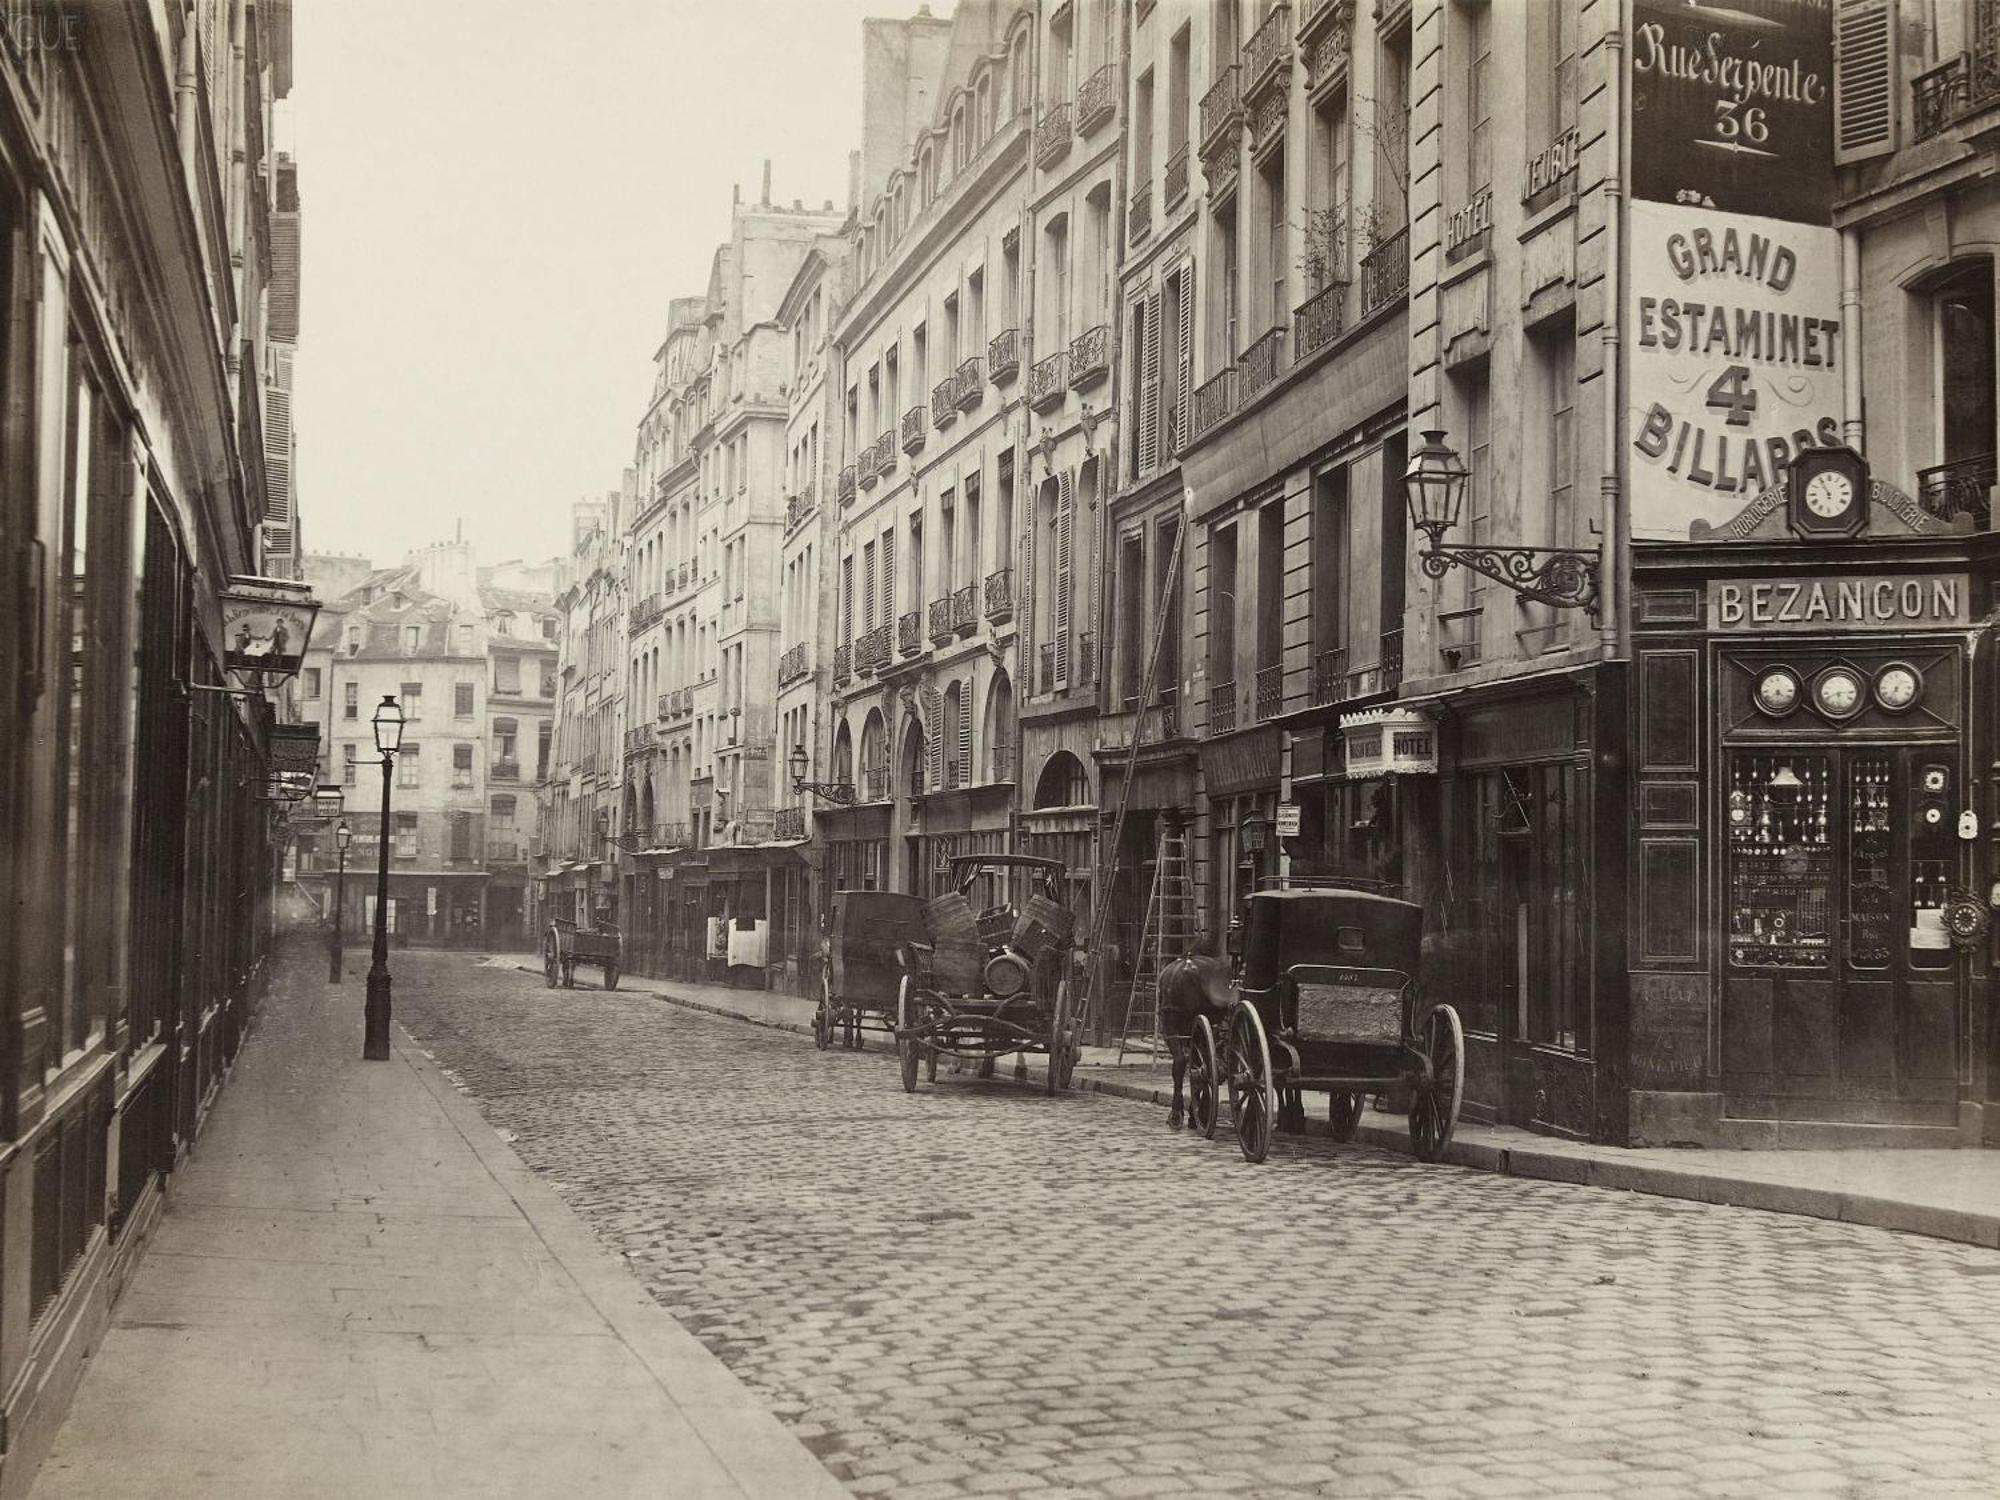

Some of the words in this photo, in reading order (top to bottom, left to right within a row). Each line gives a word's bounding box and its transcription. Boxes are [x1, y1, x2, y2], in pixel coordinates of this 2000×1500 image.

[1635, 22, 1700, 79] Rue
[1716, 100, 1769, 142] 36
[1666, 227, 1797, 292] GRAND
[1638, 296, 1840, 368] ESTAMINET
[1705, 365, 1757, 427] 4
[1730, 486, 1789, 538] HORLOGERIE
[1721, 579, 1957, 625] BEZANÇON
